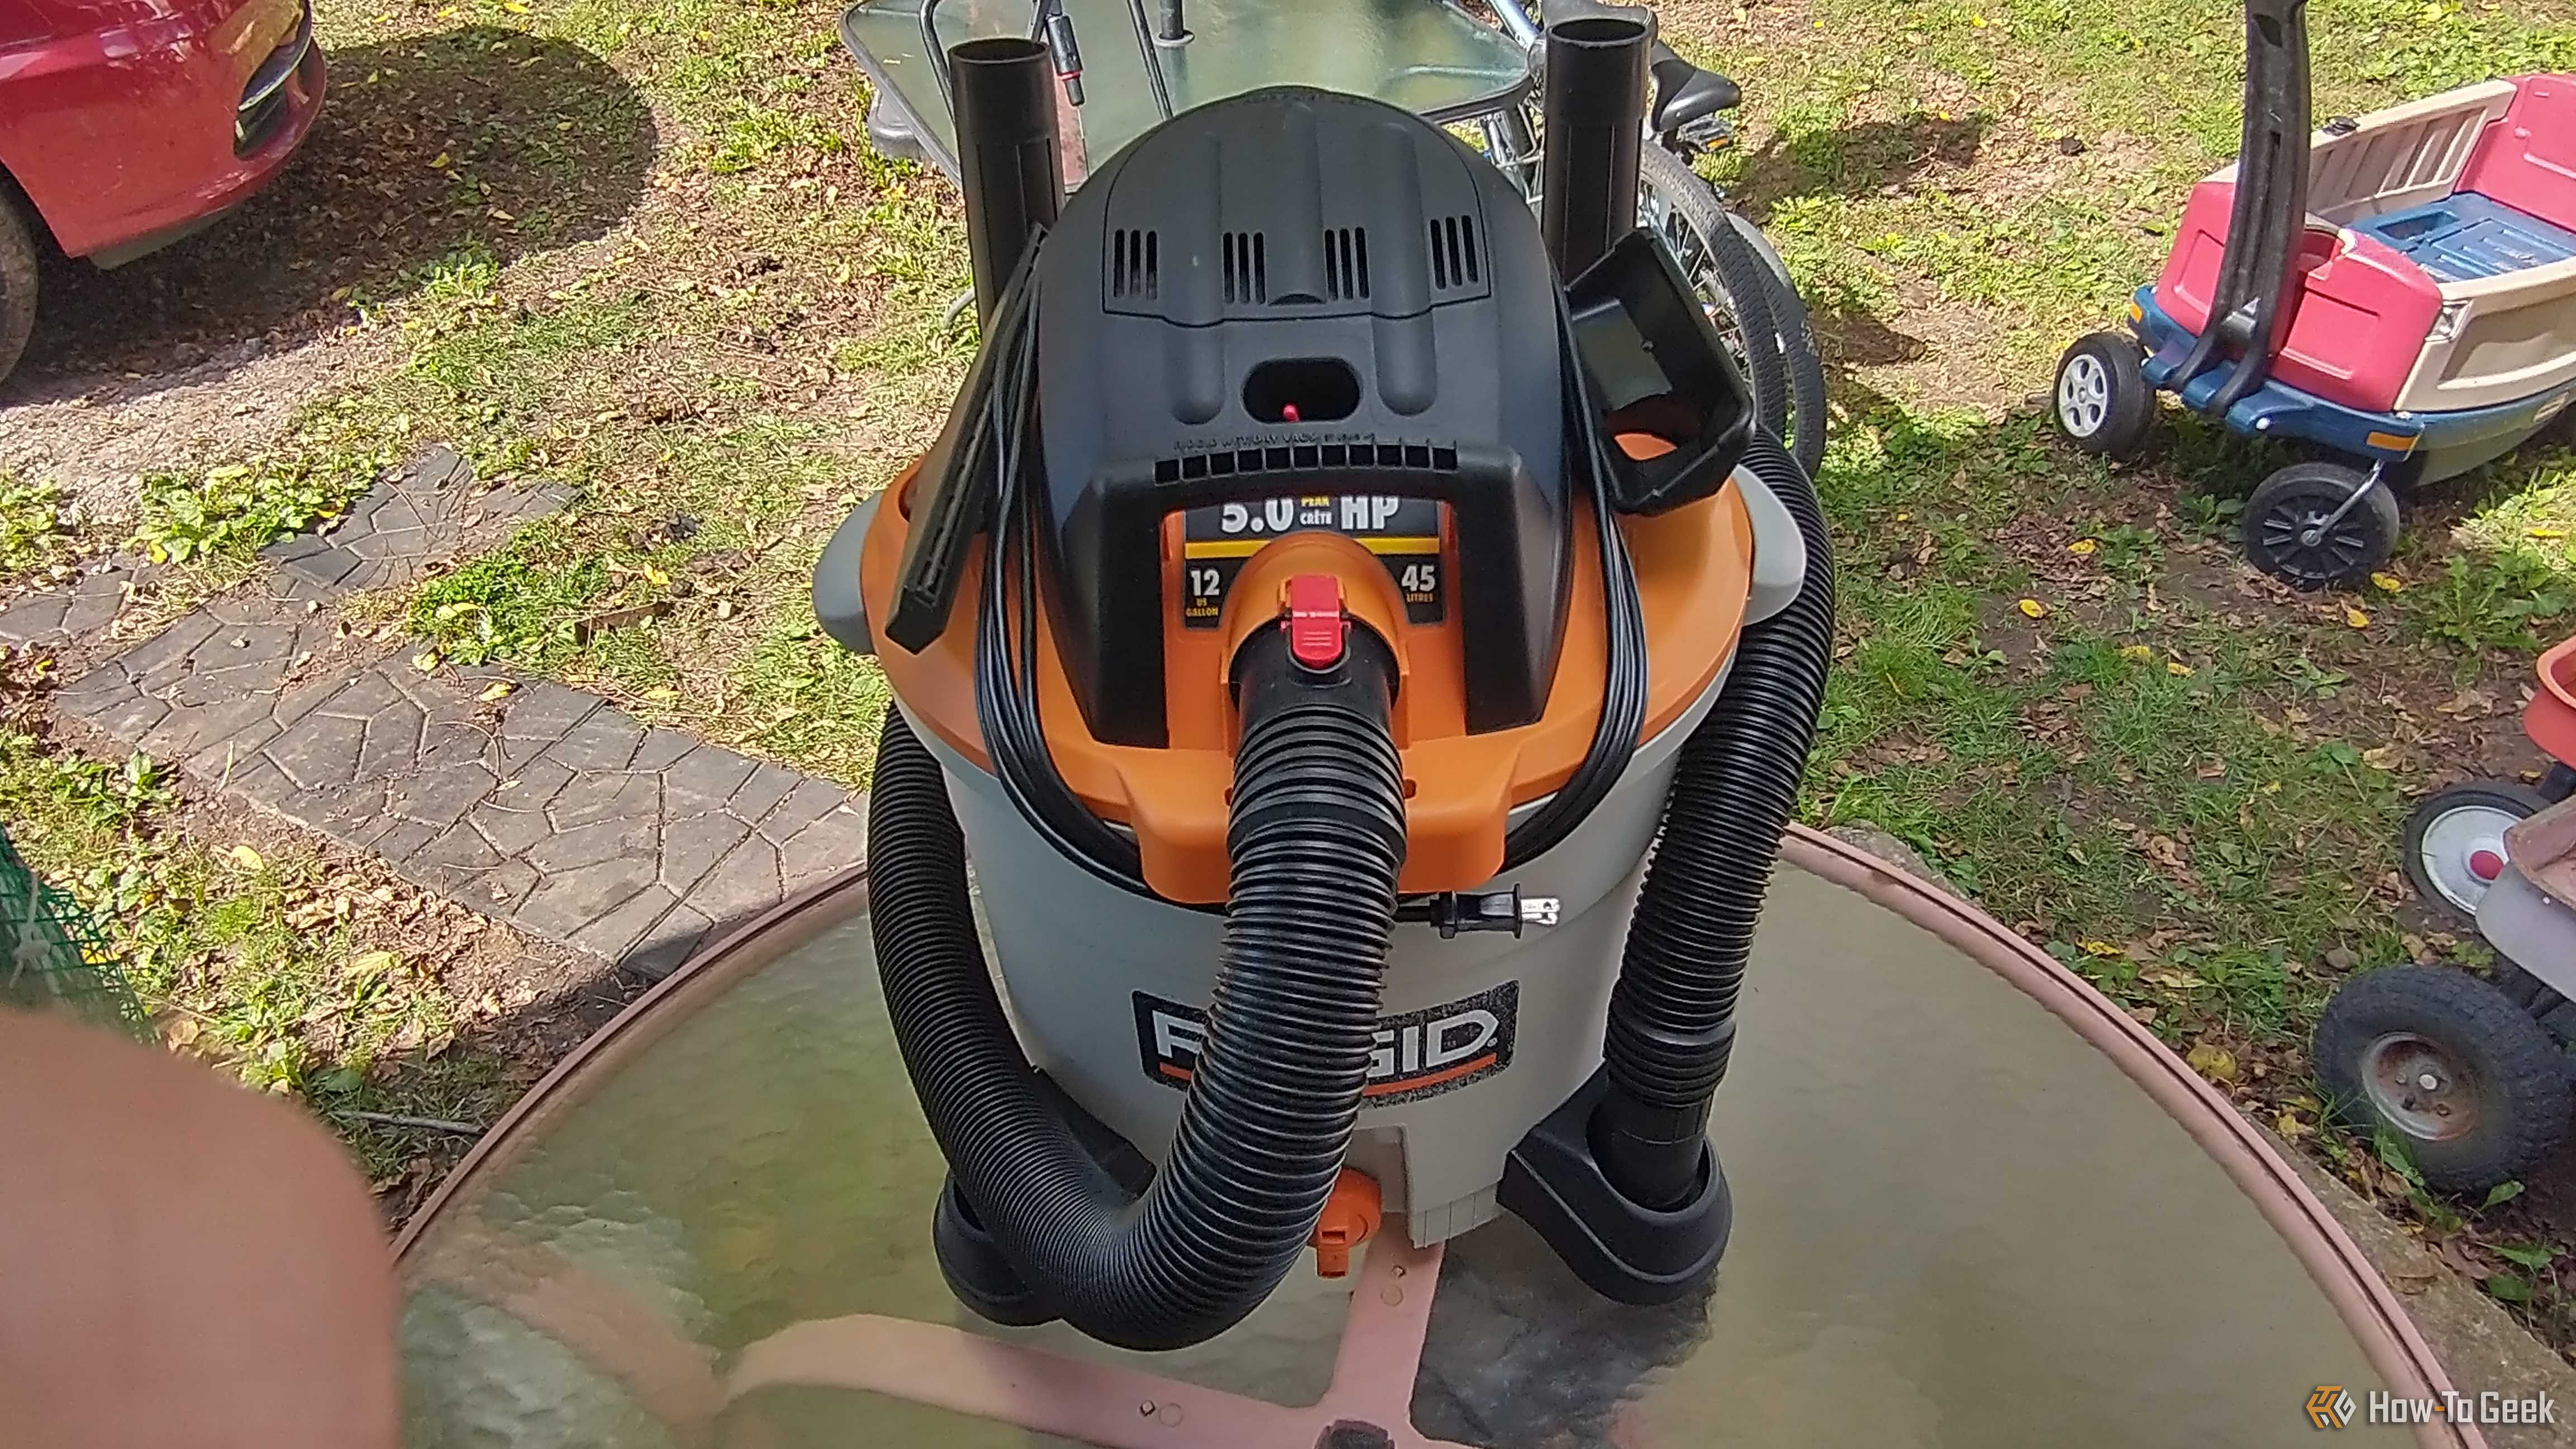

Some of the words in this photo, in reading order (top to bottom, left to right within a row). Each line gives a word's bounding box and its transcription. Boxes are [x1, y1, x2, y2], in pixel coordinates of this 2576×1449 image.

[1222, 498, 1294, 532] 5.0
[1341, 496, 1398, 529] HP
[1190, 569, 1220, 596] 12
[1401, 565, 1436, 591] 45
